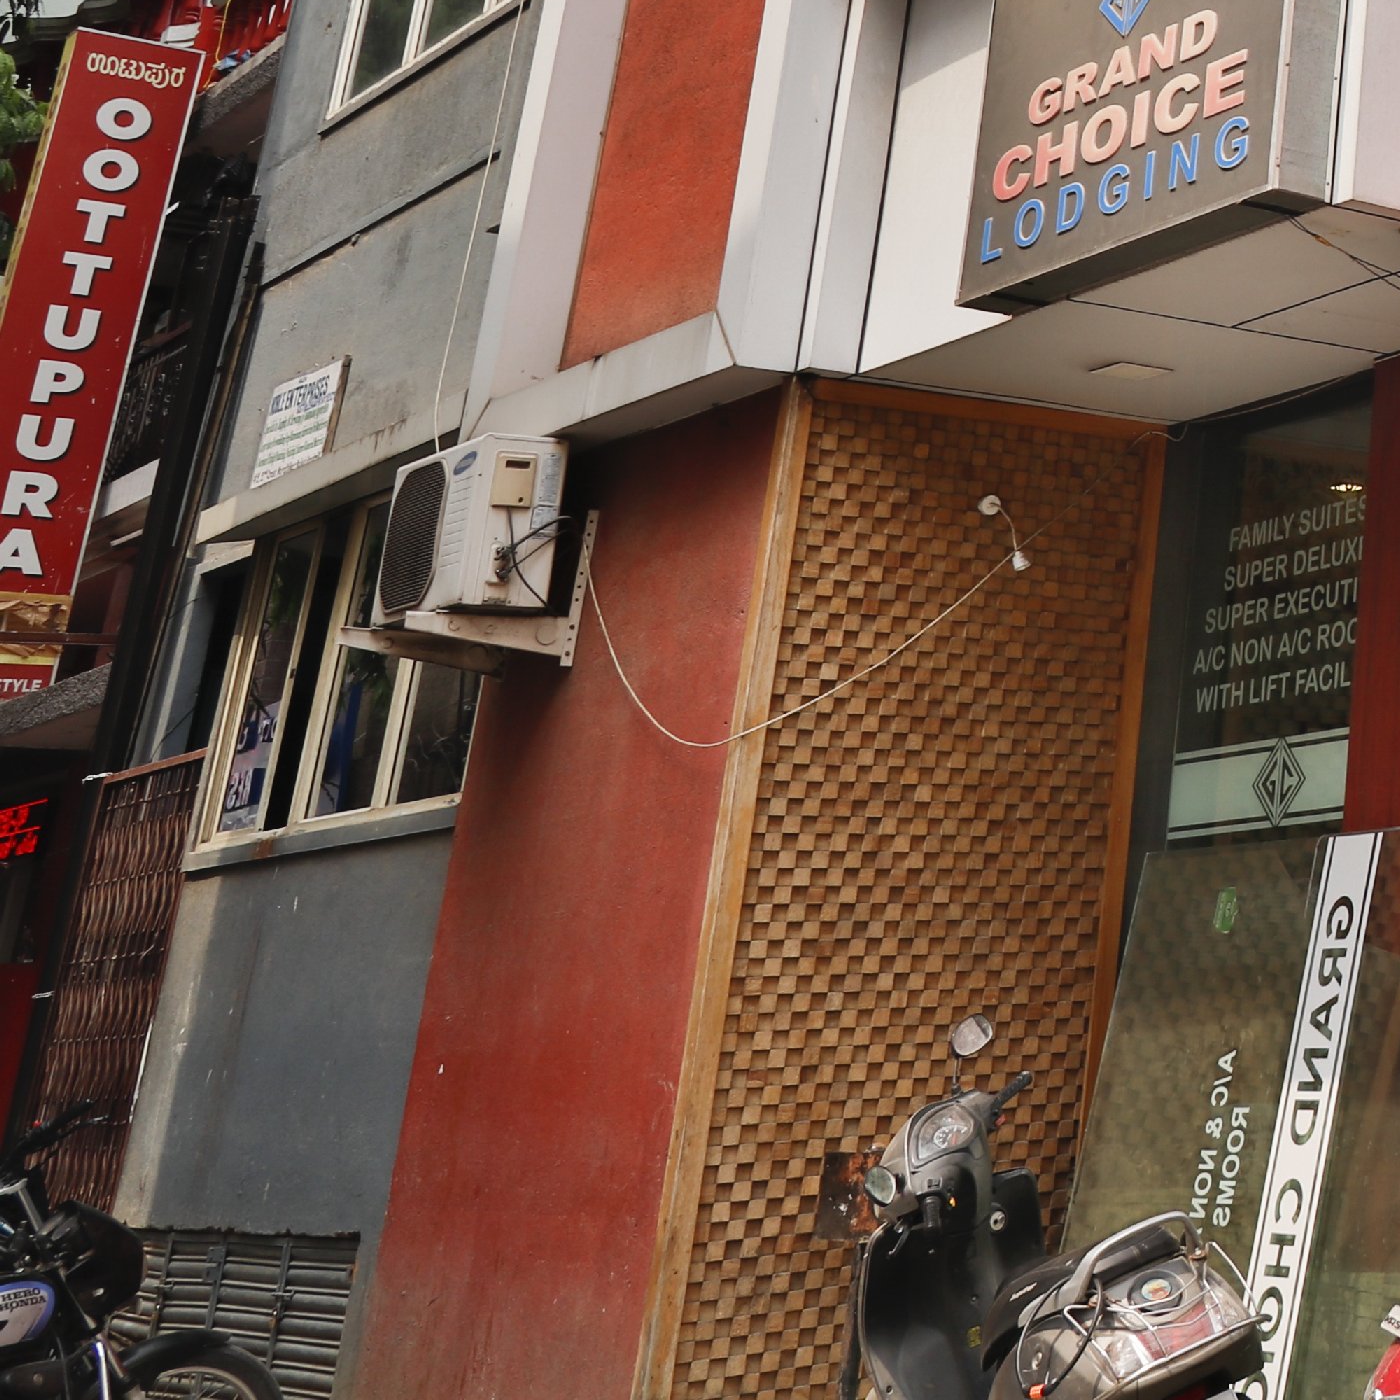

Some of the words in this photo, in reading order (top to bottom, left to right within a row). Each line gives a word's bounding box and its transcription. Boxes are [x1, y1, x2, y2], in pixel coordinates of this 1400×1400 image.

[1029, 10, 1218, 125] GRAND
[992, 49, 1249, 203] CHOICE
[980, 116, 1250, 264] LODGING
[0, 98, 152, 576] OOTTUPURA
[1229, 513, 1294, 552] FAMILY
[1225, 554, 1287, 591] SUPER
[1205, 598, 1268, 633] SUPER
[1274, 577, 1358, 619] EXECUTI
[1193, 646, 1225, 674] A/C
[1231, 635, 1272, 668] NON
[1278, 628, 1310, 658] A/C
[1197, 681, 1243, 712] WITH
[1250, 672, 1290, 703] LIFT
[1295, 661, 1351, 696] FACIL
